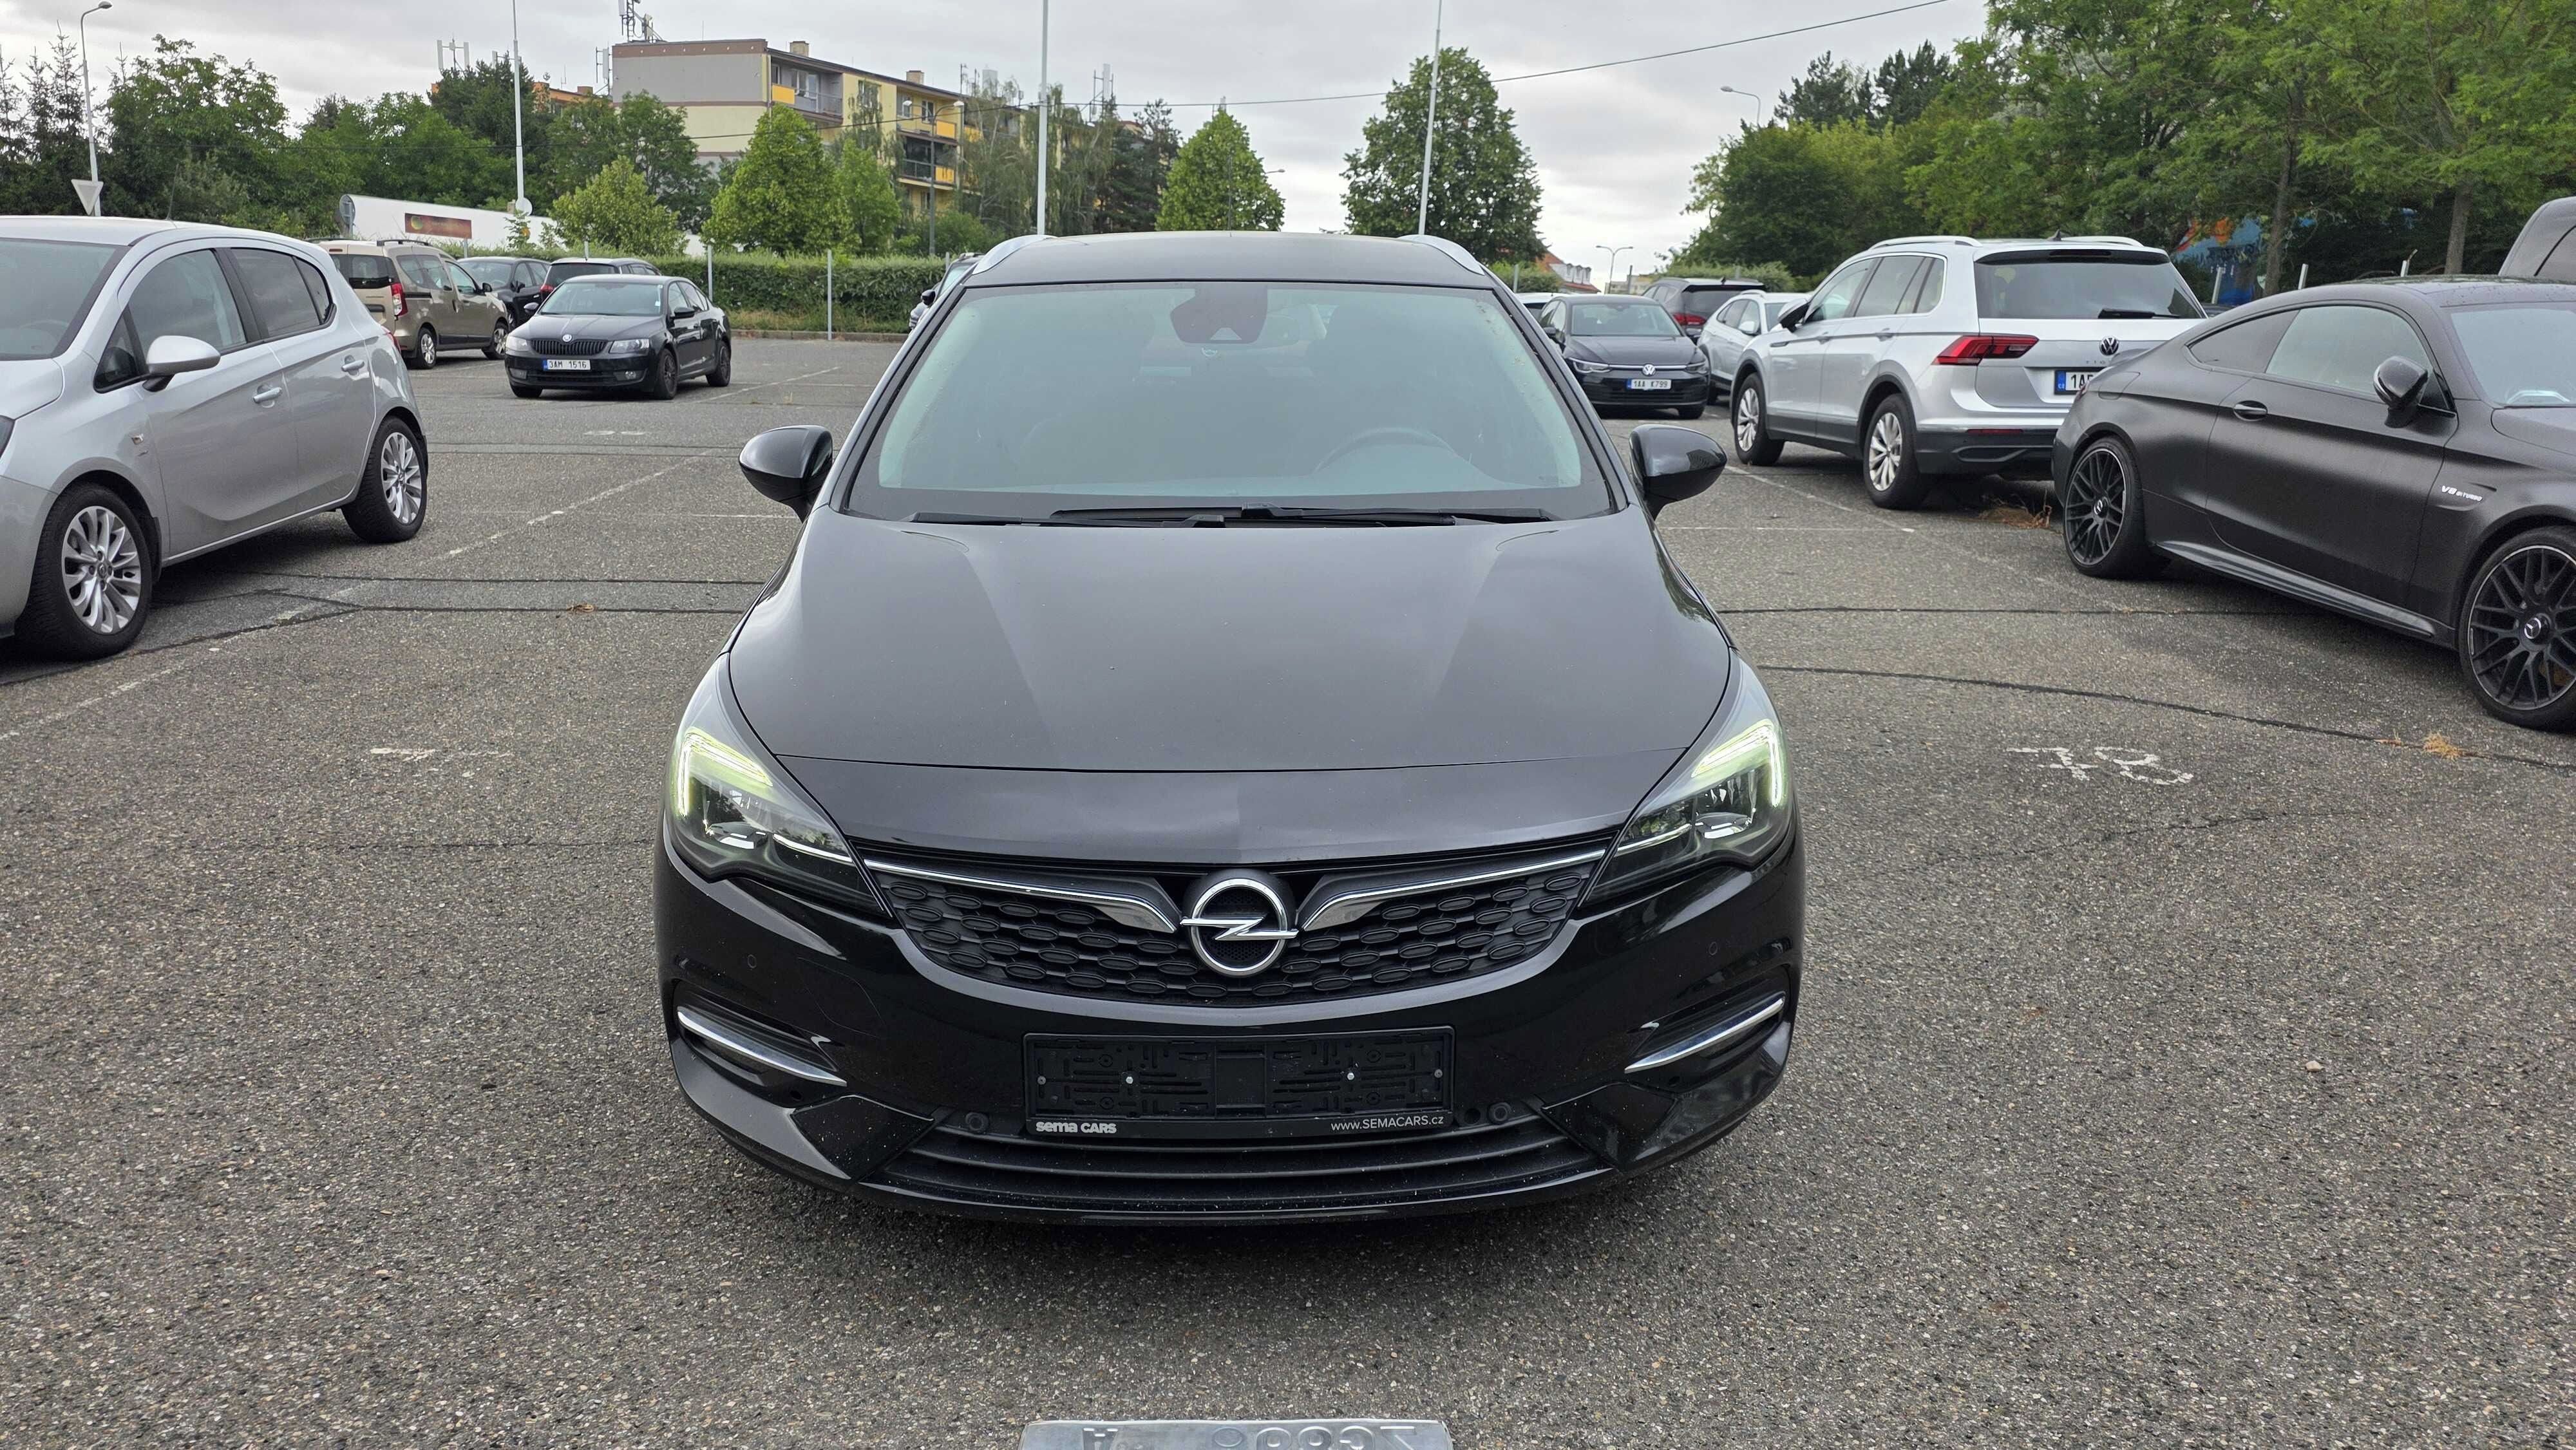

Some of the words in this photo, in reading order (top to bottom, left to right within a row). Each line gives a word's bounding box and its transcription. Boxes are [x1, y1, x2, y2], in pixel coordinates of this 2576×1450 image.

[2441, 485, 2458, 495] V8
[1036, 1121, 1078, 1133] sema
[1080, 1122, 1117, 1134] CARS
[1331, 1115, 1444, 1131] www.SEMACARS.cz
